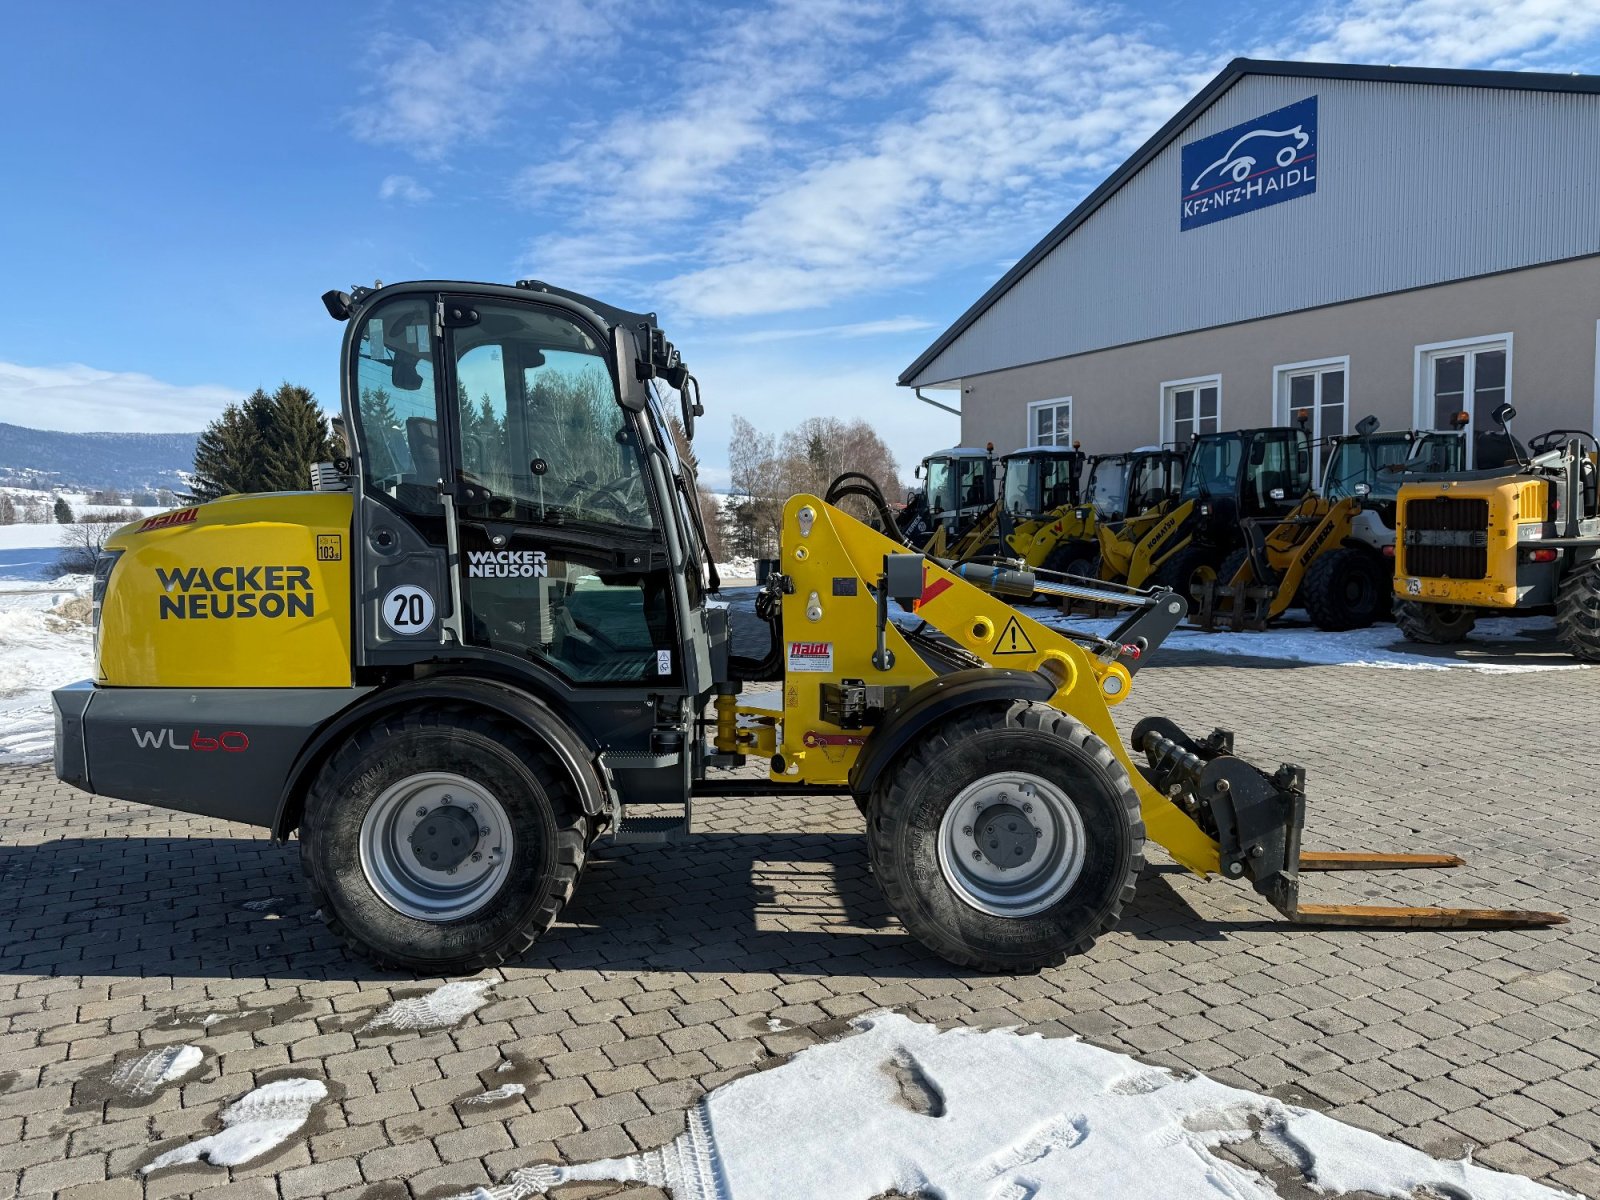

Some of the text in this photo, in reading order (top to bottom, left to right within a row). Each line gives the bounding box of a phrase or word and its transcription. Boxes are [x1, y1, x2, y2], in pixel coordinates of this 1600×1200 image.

[905, 514, 923, 536] TEREX
[1147, 518, 1176, 550] KOMATSU
[320, 546, 334, 559] 103
[1300, 519, 1335, 567] LIEBHERR
[467, 550, 548, 565] WACKER
[155, 566, 314, 593] WACKER
[468, 564, 548, 578] NEUSON
[160, 593, 315, 620] NEUSON
[393, 593, 424, 626] 20
[131, 727, 250, 753] WL60
